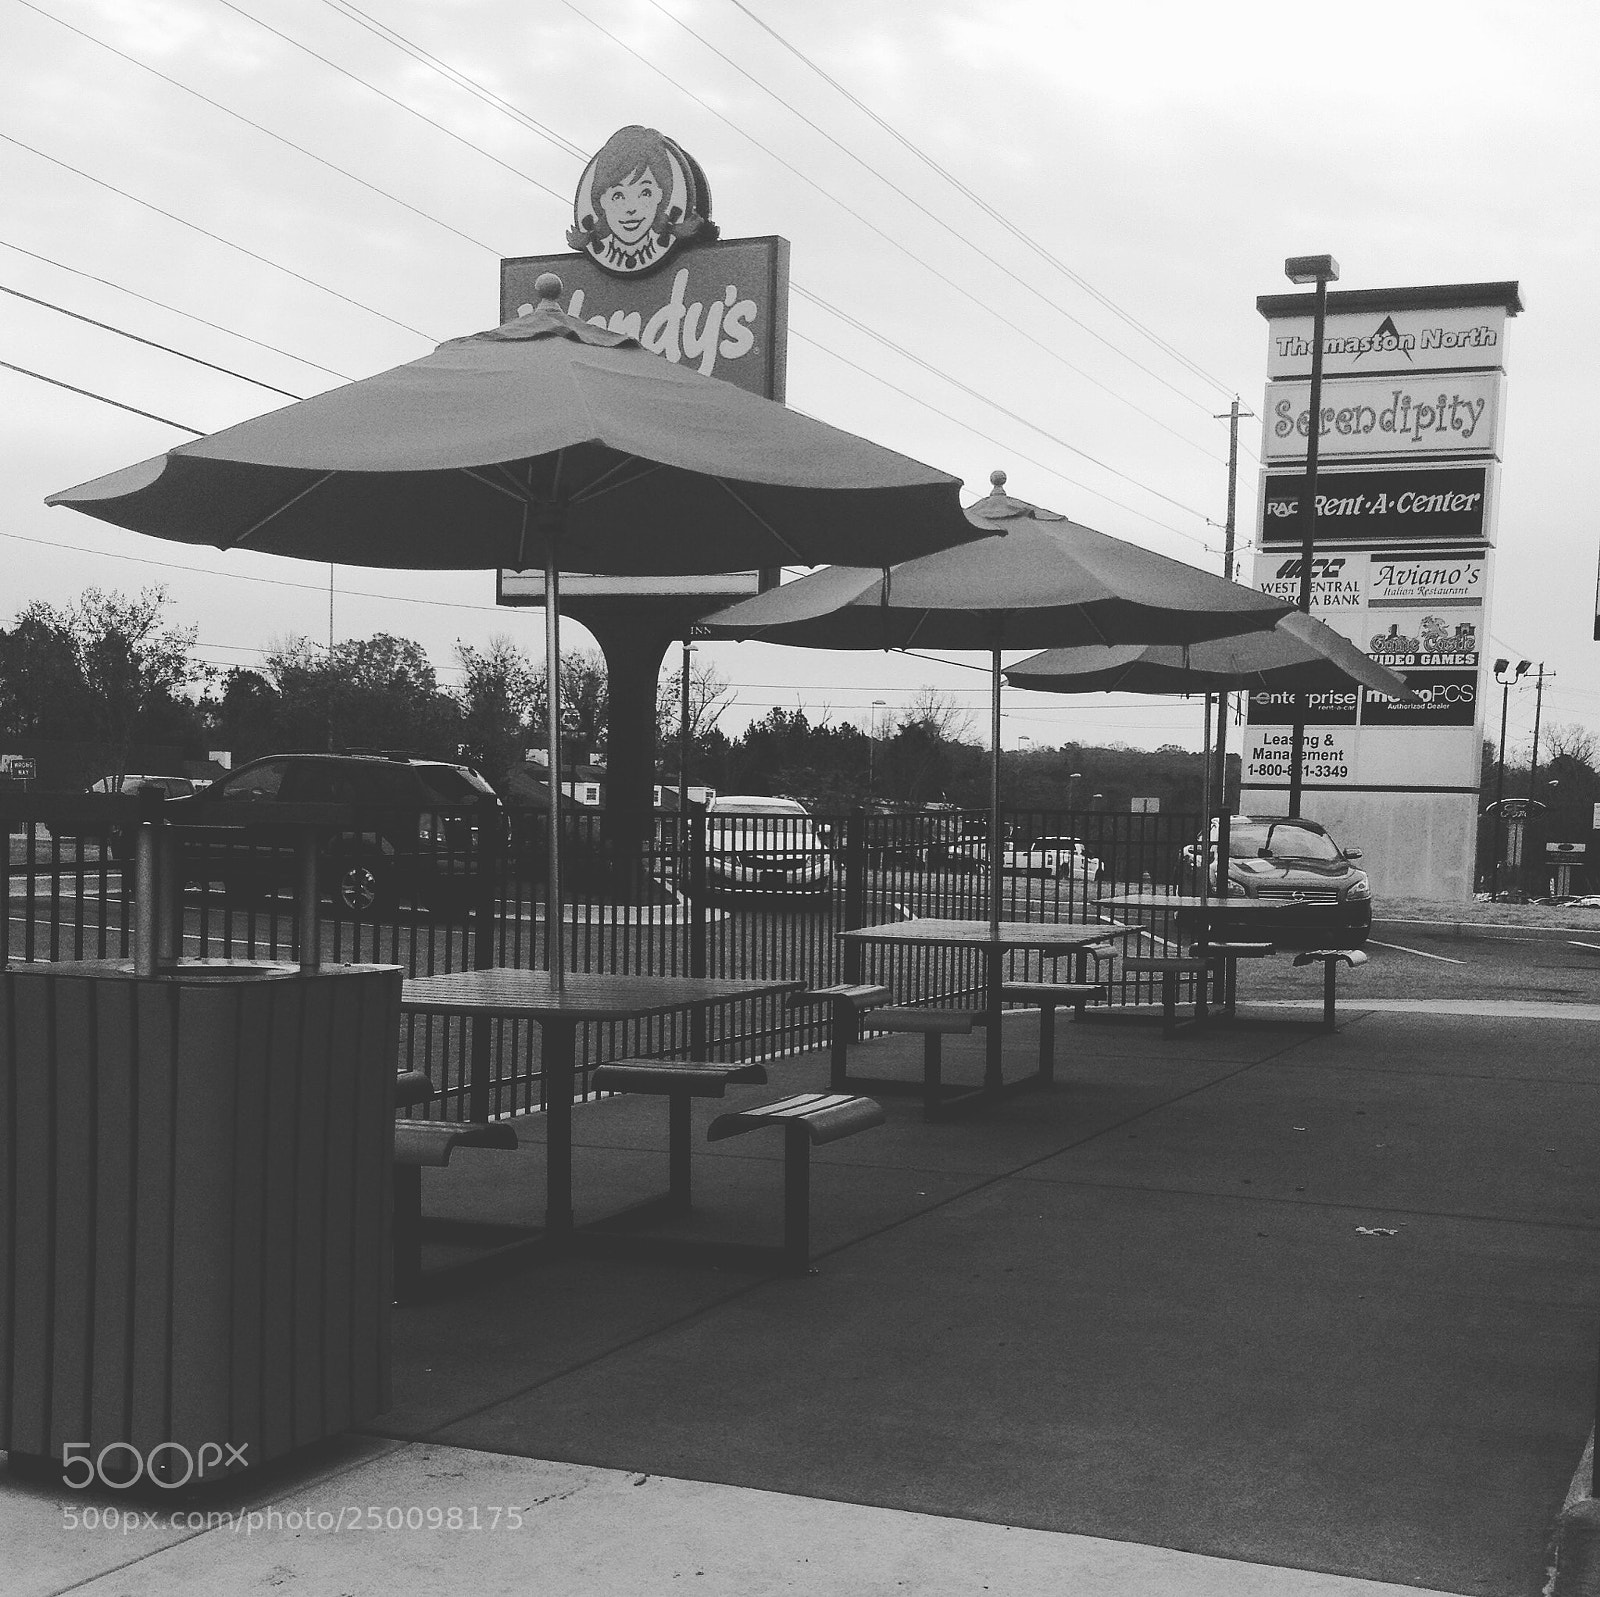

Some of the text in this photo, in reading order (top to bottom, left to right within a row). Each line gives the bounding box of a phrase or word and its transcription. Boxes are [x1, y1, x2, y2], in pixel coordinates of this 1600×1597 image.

[517, 268, 757, 377] ndy's
[1421, 326, 1497, 350] North
[1274, 390, 1485, 443] Serendipity
[1267, 501, 1299, 518] RAC
[1373, 563, 1481, 587] Aviano's
[1261, 580, 1360, 593] WEST ENTRAL
[1383, 585, 1469, 597] Italian Restaurant
[1323, 594, 1360, 605] BANK
[690, 626, 711, 635] INN
[1370, 633, 1420, 653] Game
[1420, 653, 1476, 665] GAMES
[1252, 689, 1357, 708] enteprise
[1263, 733, 1334, 749] Leasng &
[1252, 747, 1344, 761] Manaement
[1247, 763, 1348, 778] 1-800-81-3349
